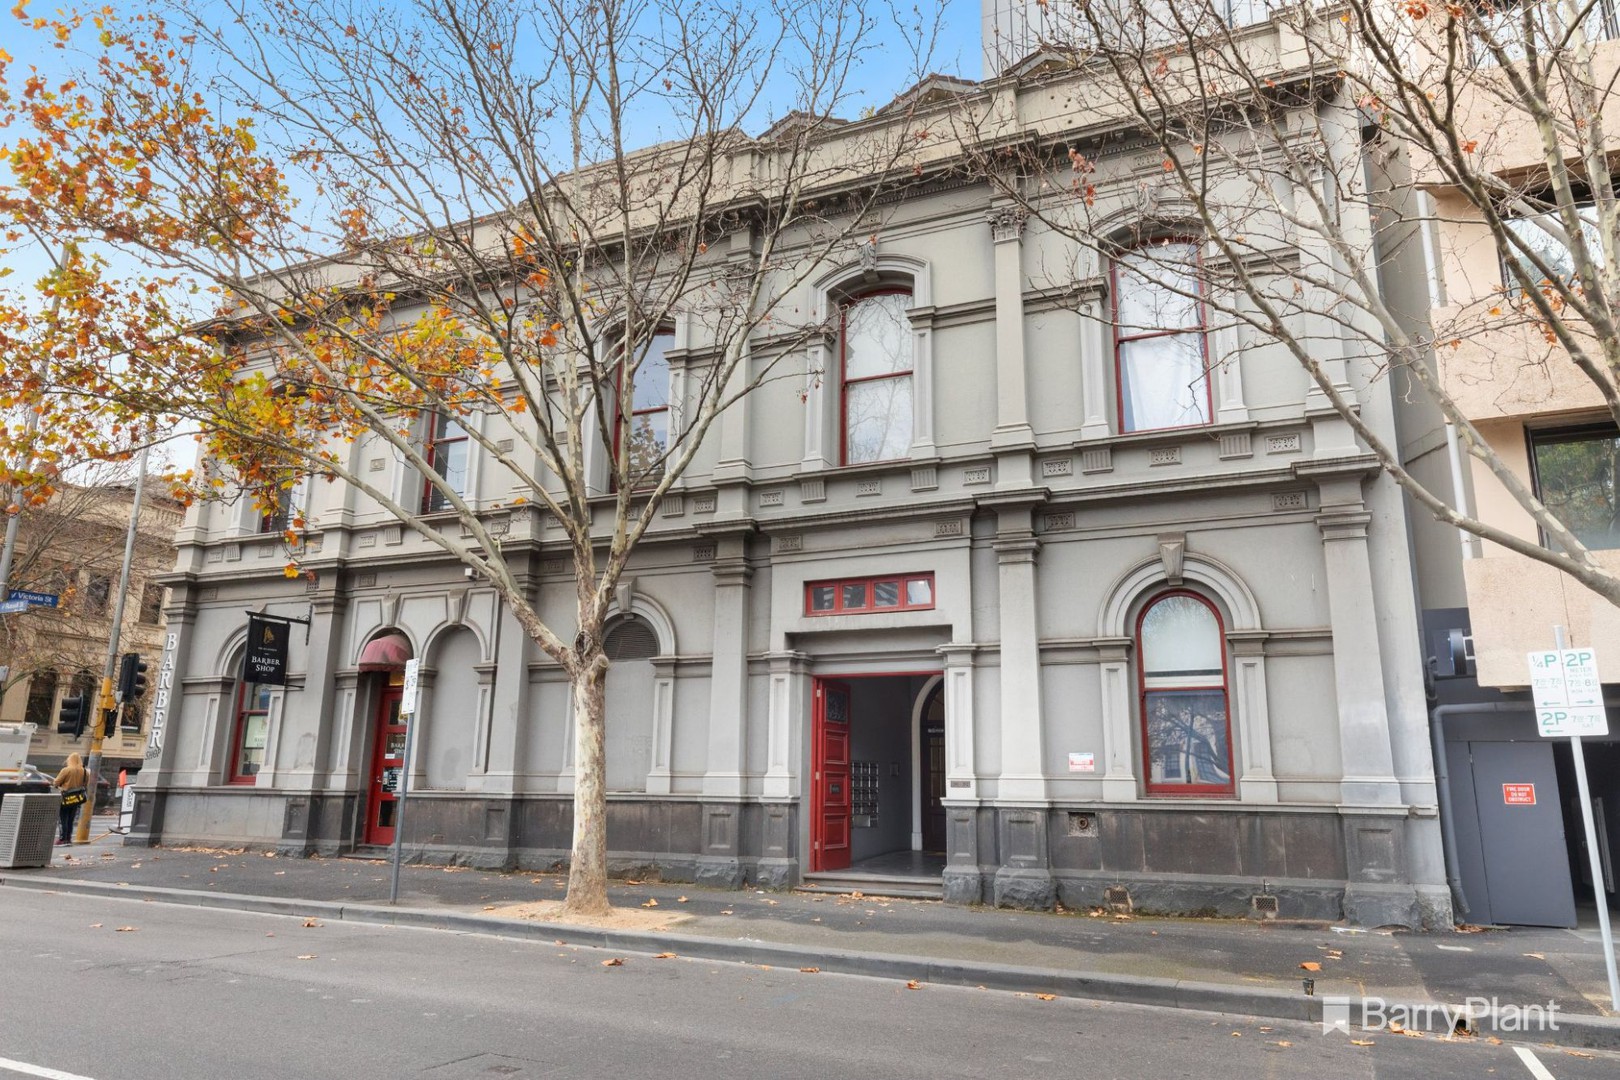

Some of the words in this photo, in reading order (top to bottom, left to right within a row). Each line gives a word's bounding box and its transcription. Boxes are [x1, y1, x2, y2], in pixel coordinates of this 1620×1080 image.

[18, 592, 44, 602] Victoria
[251, 655, 281, 666] BARBER
[1565, 652, 1592, 667] 2P
[255, 664, 275, 673] SHOP
[149, 632, 178, 748] BARBER
[1541, 711, 1568, 726] 2P
[145, 749, 161, 760] SHOP
